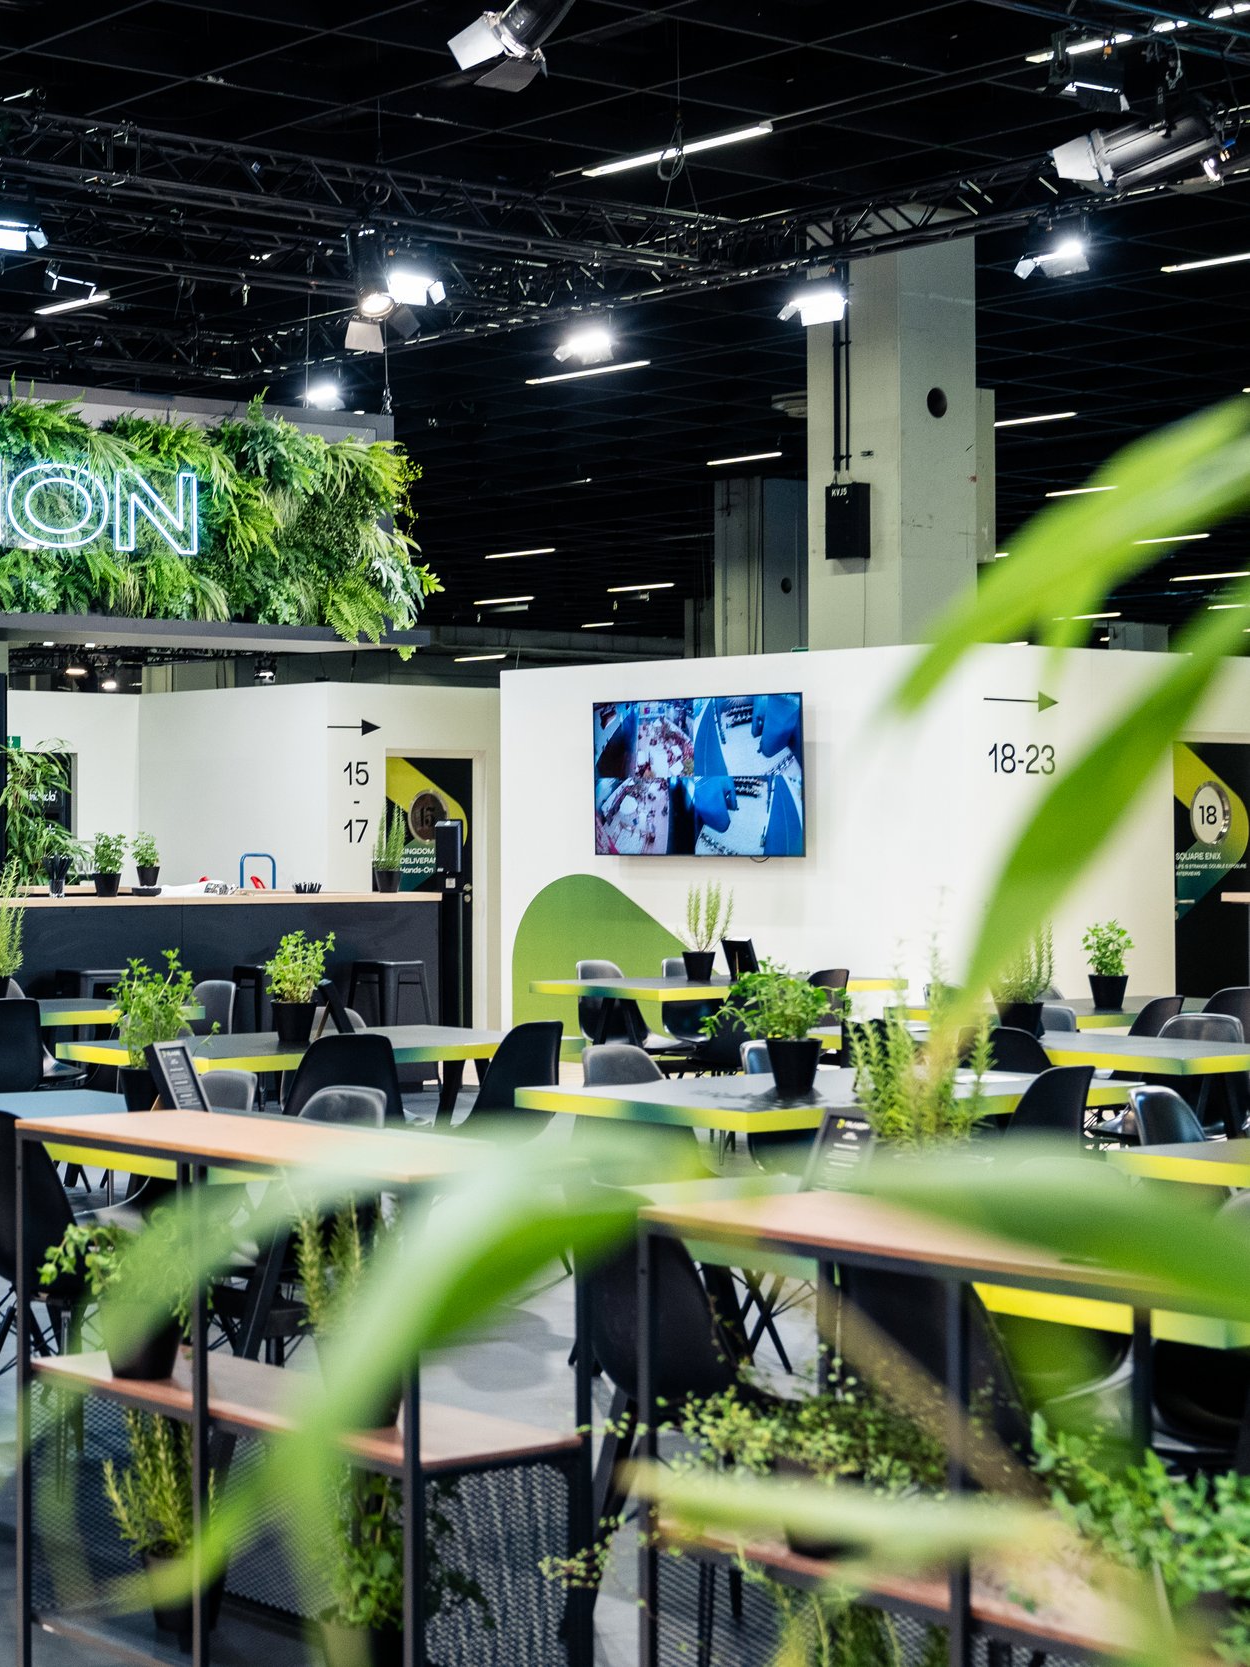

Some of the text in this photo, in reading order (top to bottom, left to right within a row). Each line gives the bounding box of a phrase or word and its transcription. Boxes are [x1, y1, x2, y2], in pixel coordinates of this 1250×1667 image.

[988, 742, 1056, 776] 18-23
[343, 761, 370, 786] 15
[1199, 805, 1217, 825] 18
[343, 819, 369, 844] 17
[1175, 852, 1222, 862] SQUARE ENIX
